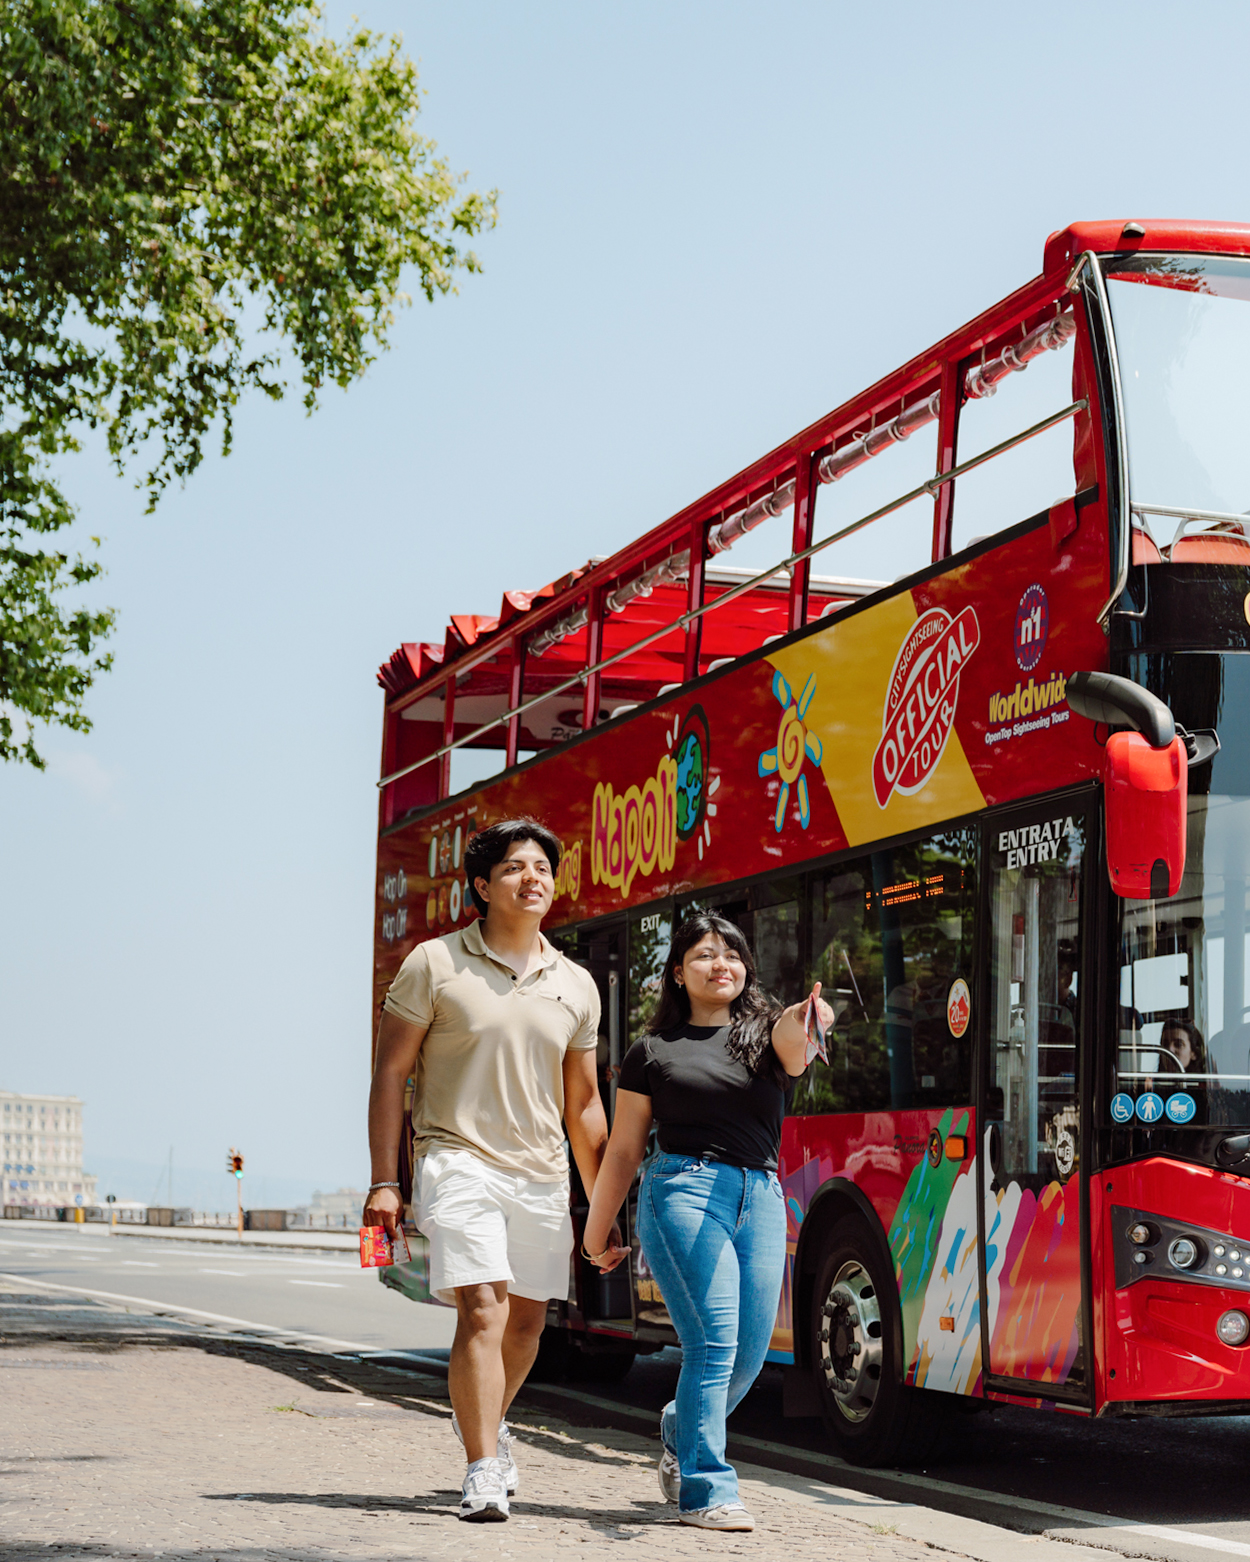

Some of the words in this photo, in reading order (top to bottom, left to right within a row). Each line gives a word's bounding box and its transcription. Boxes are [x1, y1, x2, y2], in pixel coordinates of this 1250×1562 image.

[890, 617, 944, 709] CITYSIGHTSEEING
[882, 620, 974, 784] OFFICIAL
[1012, 716, 1051, 736] Sightseeing
[1051, 711, 1070, 725] Tours
[912, 699, 954, 778] TOUR
[591, 757, 678, 899] Napoli
[998, 816, 1075, 852] ENTRATA
[1007, 838, 1061, 870] ENTRY
[641, 913, 661, 933] EXIT
